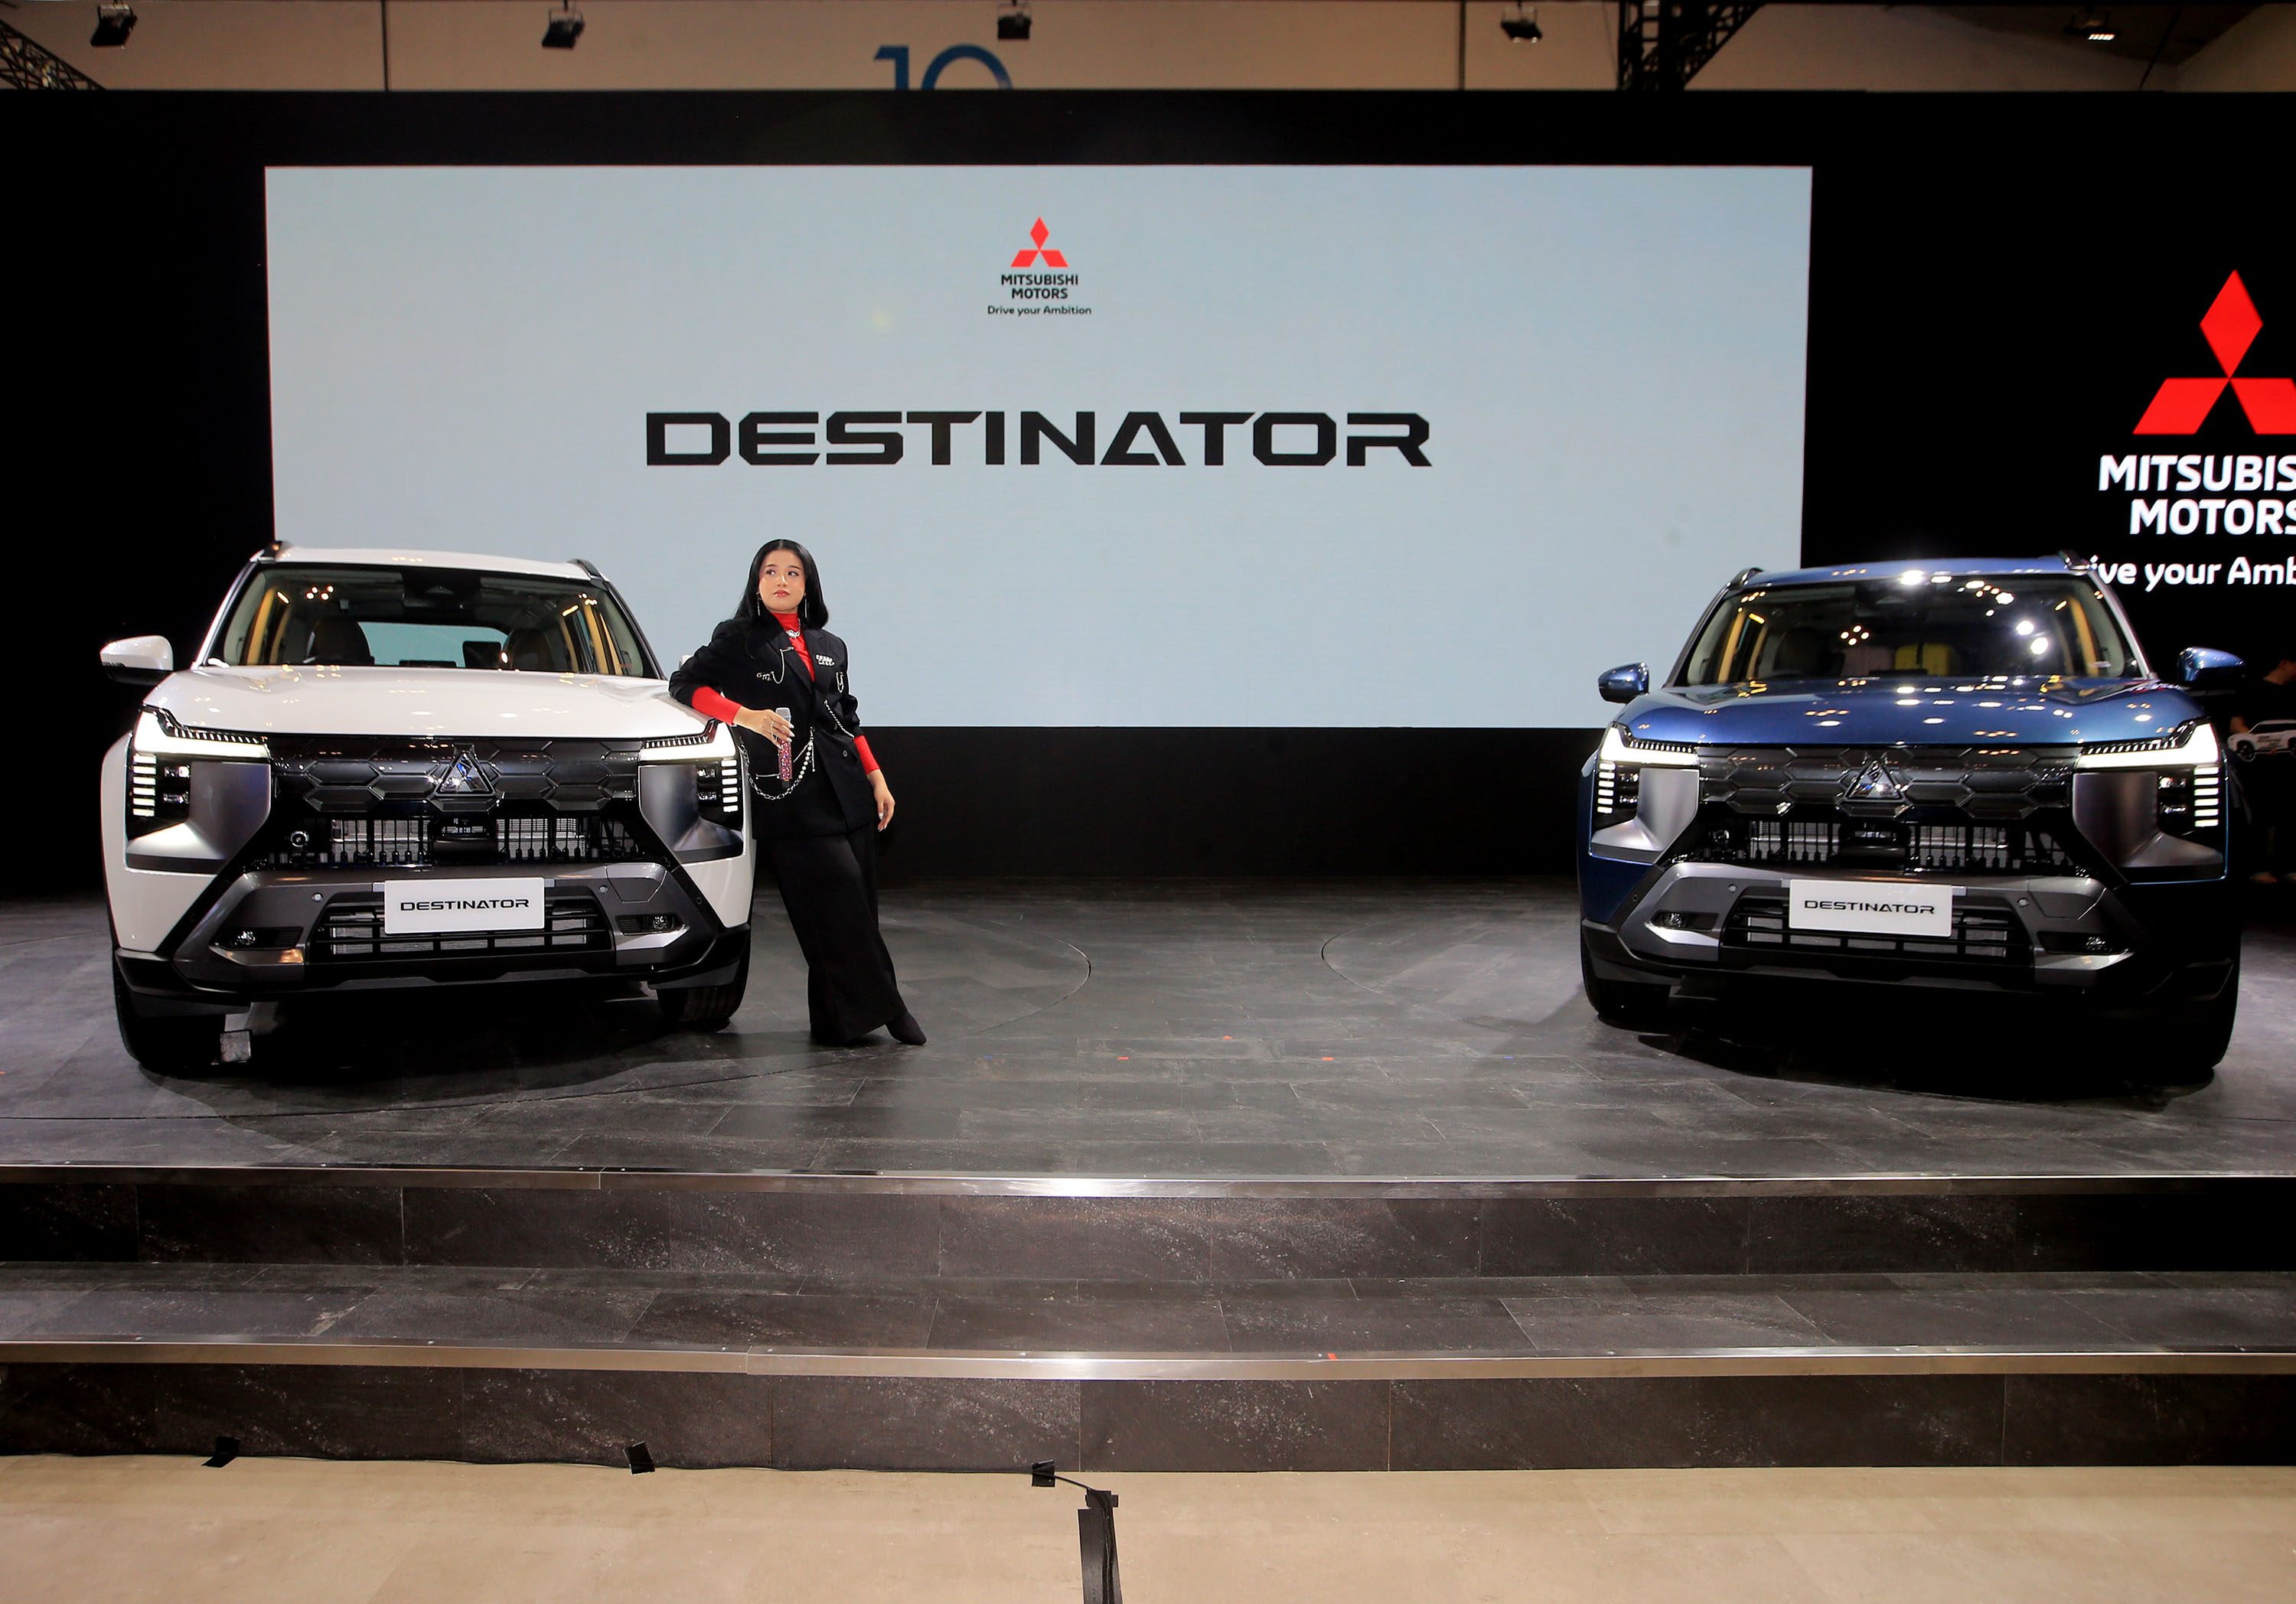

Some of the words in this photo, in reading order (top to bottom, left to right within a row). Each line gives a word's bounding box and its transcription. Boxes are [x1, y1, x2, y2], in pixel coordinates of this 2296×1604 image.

[1000, 274, 1078, 285] MITSUBISHI
[1011, 288, 1068, 299] MOTORS
[987, 305, 1015, 315] Drive
[1017, 308, 1041, 317] your
[1043, 305, 1092, 315] Ambition
[646, 411, 1433, 467] DESTINATOR
[2099, 455, 2296, 491] MITSUBIS
[2144, 563, 2222, 592] your
[400, 898, 530, 911] DESTINATOR
[1804, 900, 1936, 914] DESTINATOR
